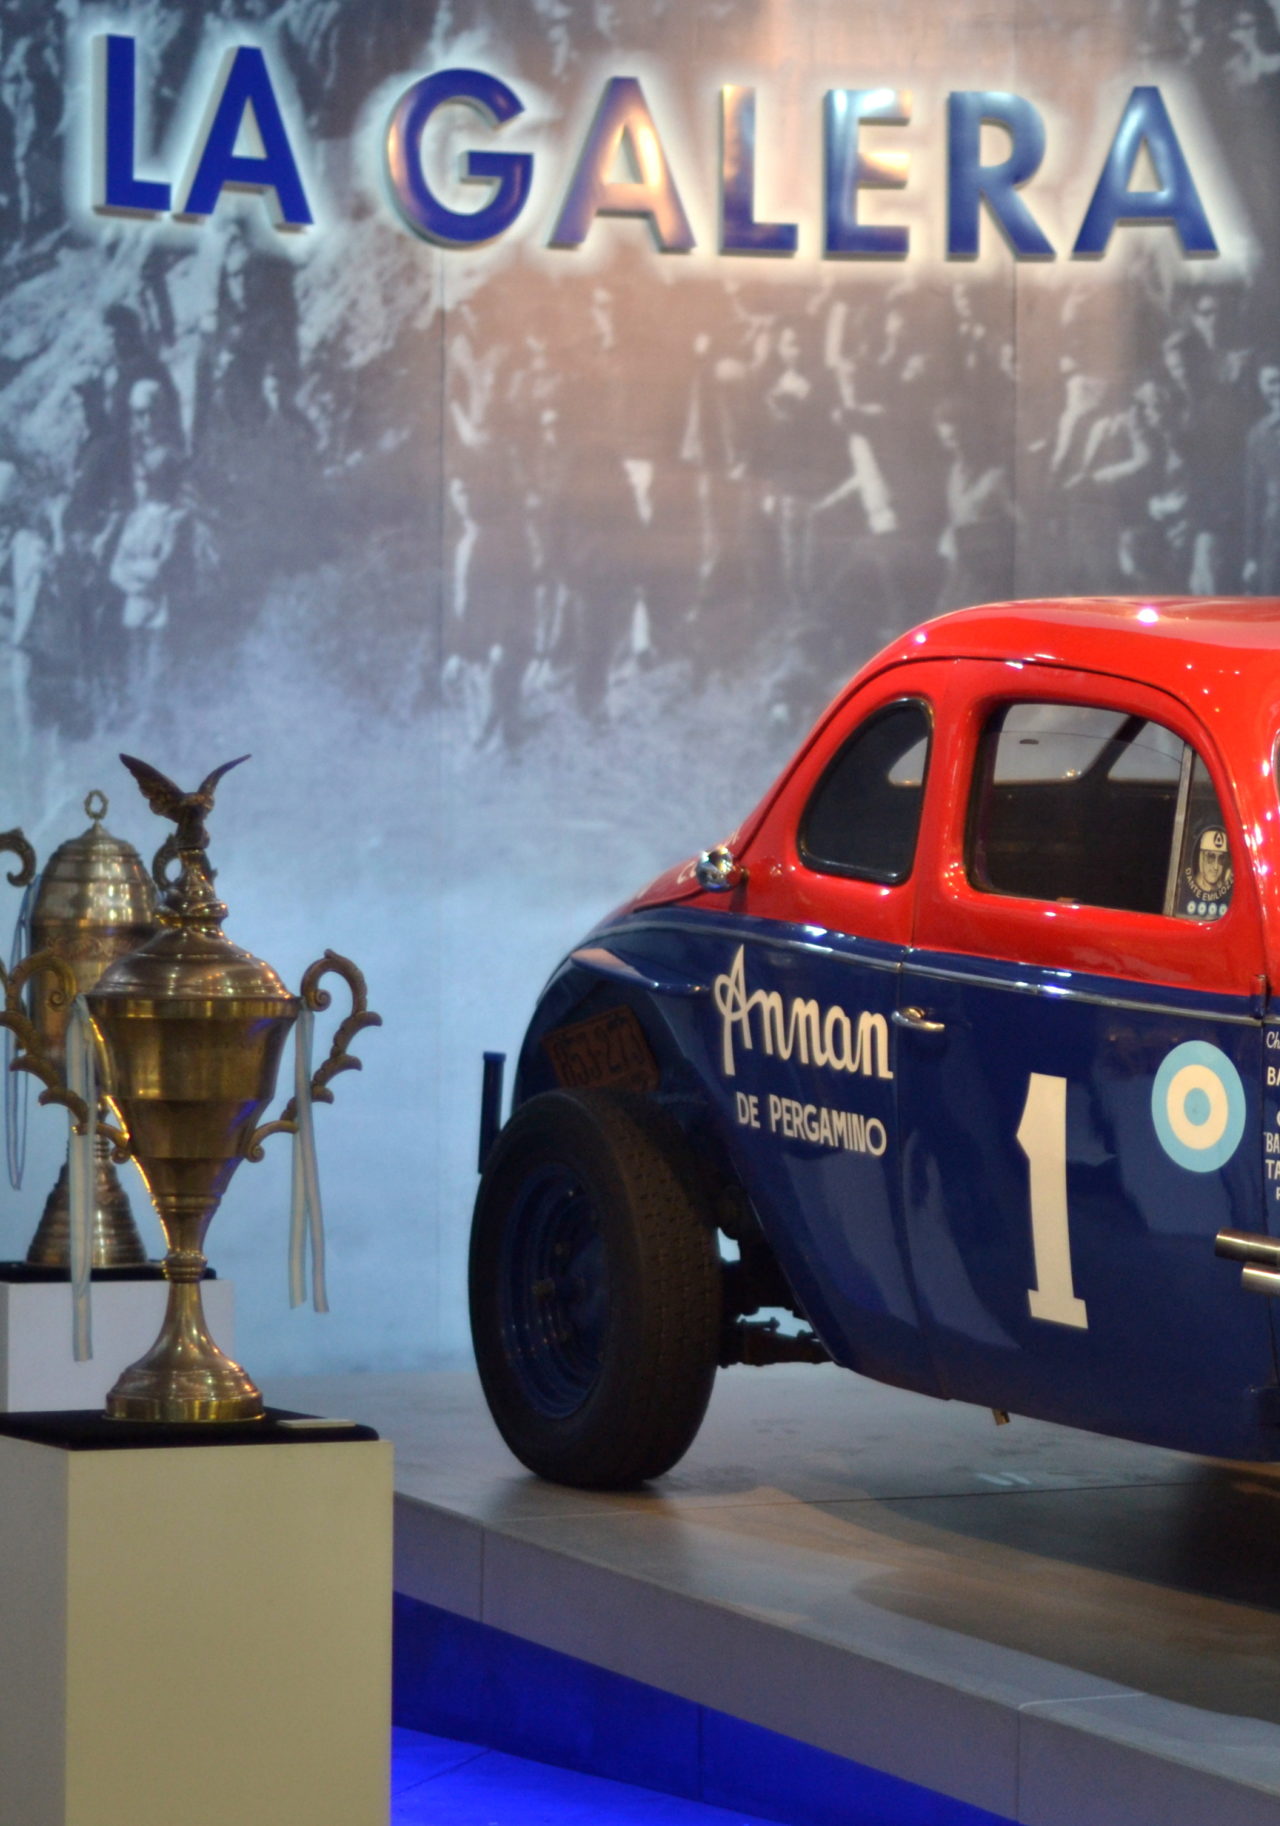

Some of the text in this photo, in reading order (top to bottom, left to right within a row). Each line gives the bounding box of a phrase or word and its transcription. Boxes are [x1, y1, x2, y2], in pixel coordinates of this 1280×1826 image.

[95, 34, 1219, 260] LA GALERA
[714, 944, 893, 1080] Annan
[737, 1091, 887, 1158] DE PERGAMINO
[1017, 1072, 1088, 1330] 1
